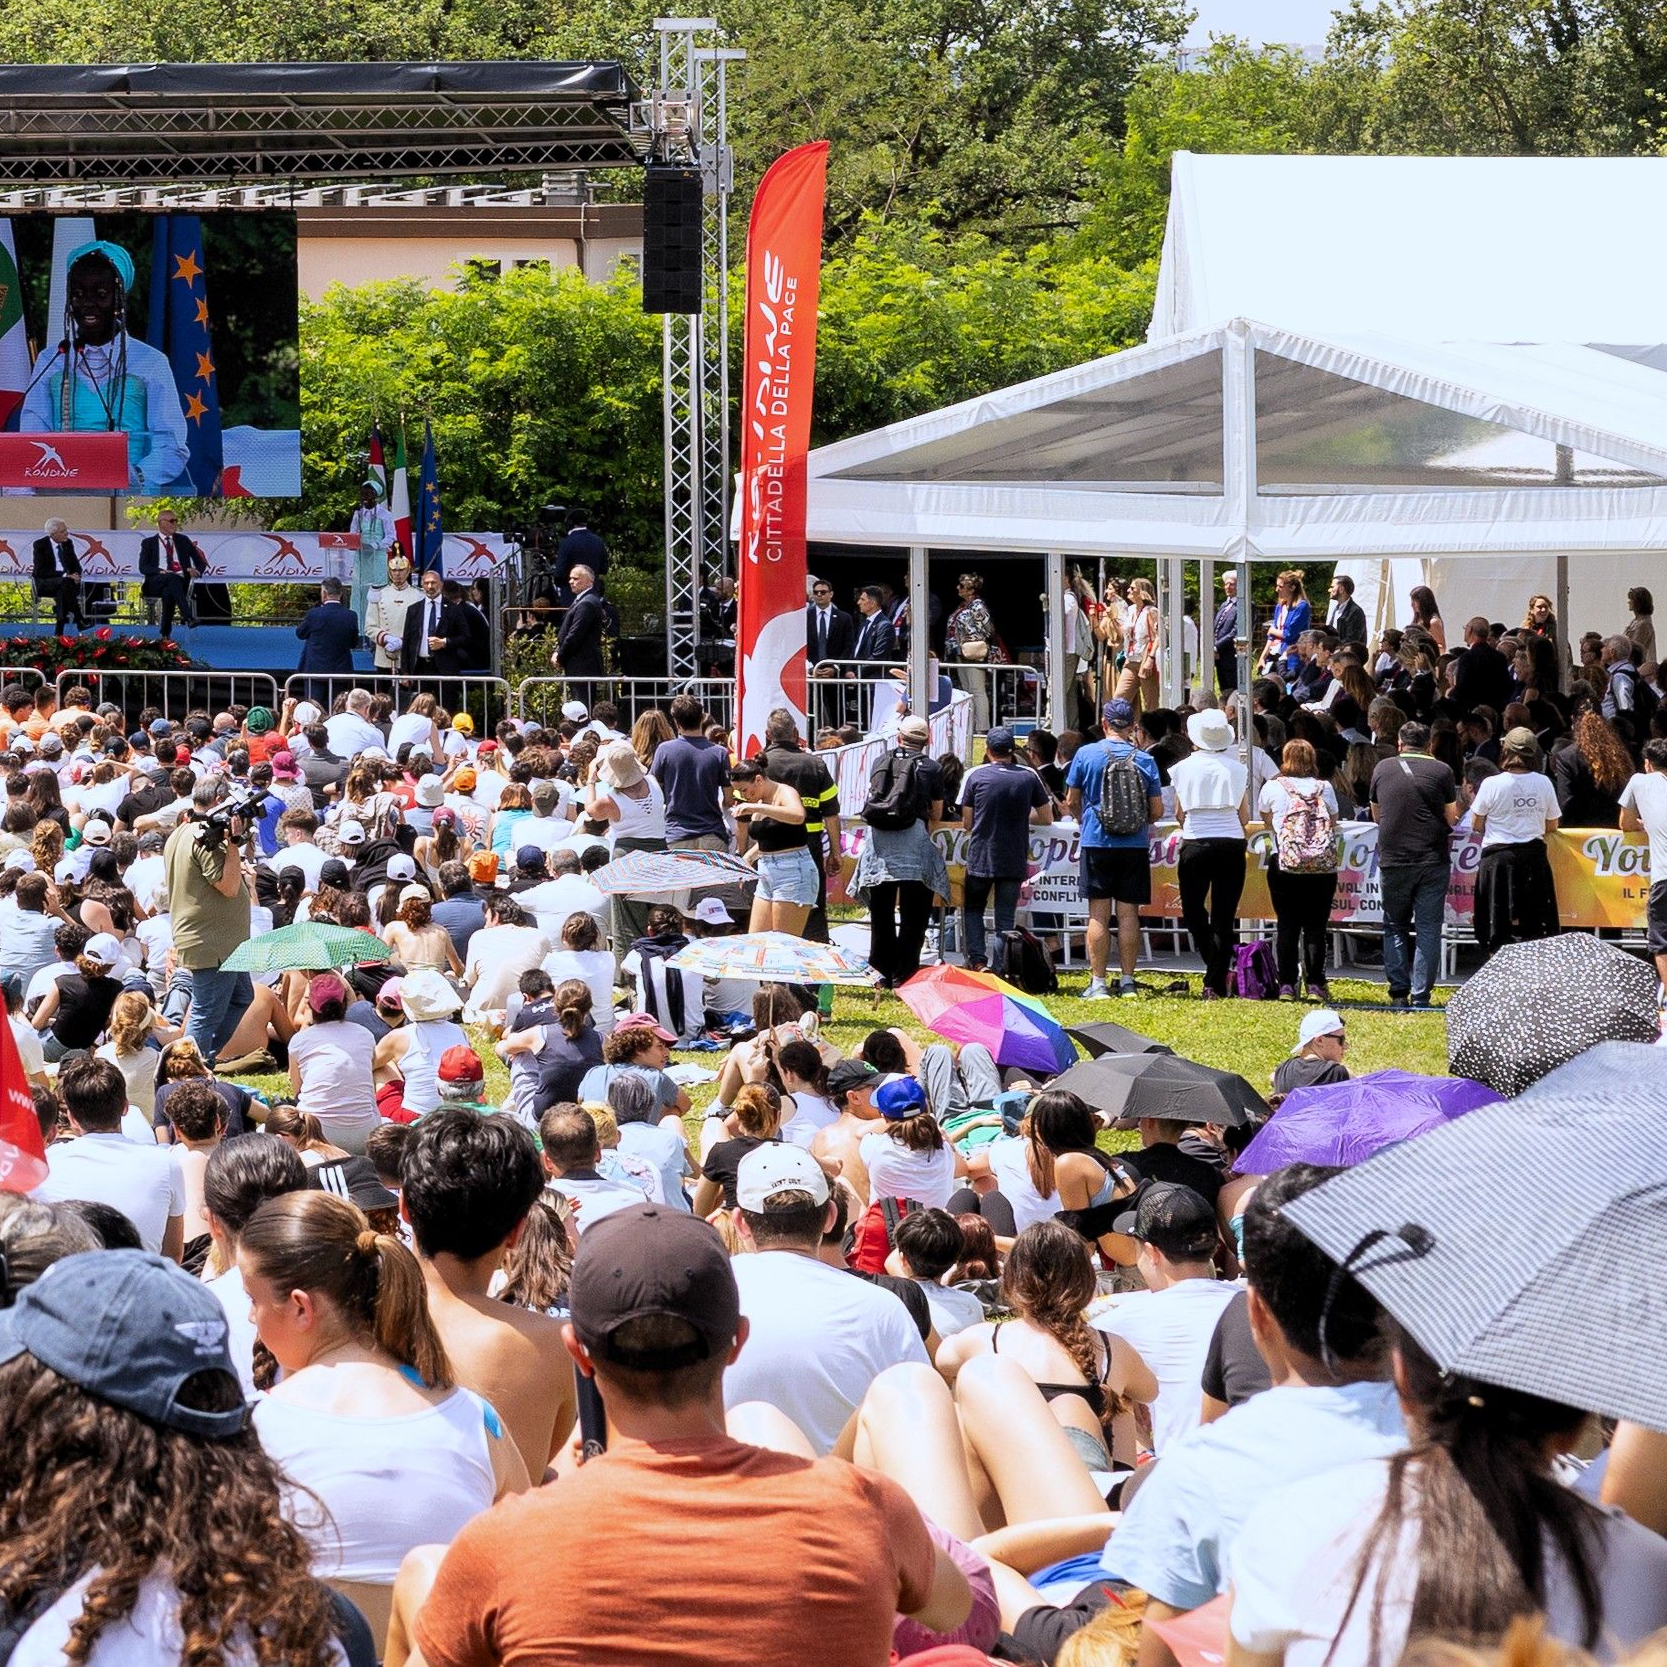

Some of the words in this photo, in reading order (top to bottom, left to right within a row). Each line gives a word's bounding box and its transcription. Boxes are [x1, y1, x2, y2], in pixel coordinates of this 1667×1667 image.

[779, 275, 799, 336] PACE
[769, 343, 792, 417] DELLA
[24, 467, 79, 478] RONDINE
[766, 423, 787, 563] CITTADELLA
[83, 564, 132, 575] NDINE
[253, 565, 323, 576] RONDINE
[1513, 797, 1537, 808] 100
[1033, 890, 1083, 903] CONFLIT
[1623, 887, 1635, 899] IL
[1331, 899, 1356, 911] SUL
